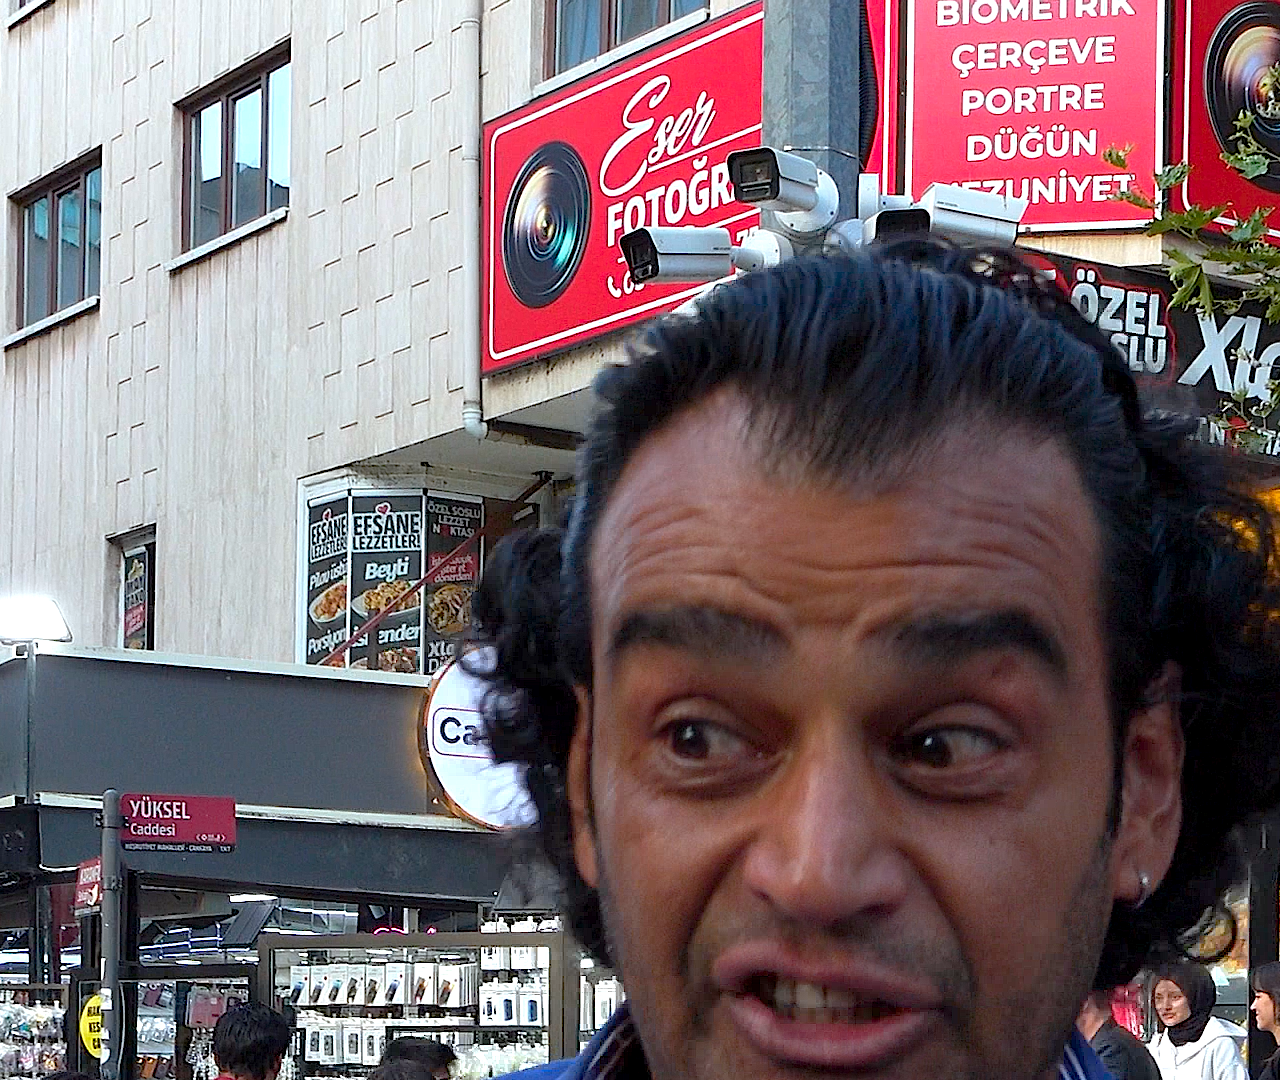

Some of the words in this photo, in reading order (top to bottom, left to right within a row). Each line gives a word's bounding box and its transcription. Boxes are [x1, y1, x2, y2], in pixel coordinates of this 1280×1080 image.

[951, 36, 1116, 78] ÇERÇEVE
[962, 83, 1105, 117] PORTRE
[599, 75, 716, 197] Eser
[966, 124, 1097, 162] DÜĞÜN
[607, 156, 736, 248] FOTOĞR
[1071, 267, 1167, 338] ÖZEL
[353, 513, 421, 537] EFSANE
[427, 502, 451, 515] ÖZEL
[452, 506, 481, 519] SOSLU
[438, 515, 470, 526] LEZZET
[311, 514, 348, 548] EFSANE
[353, 534, 421, 550] LEZZETLER!
[365, 556, 410, 582] Beyti
[129, 797, 190, 820] YÜKSEL
[130, 823, 176, 837] Caddesi
